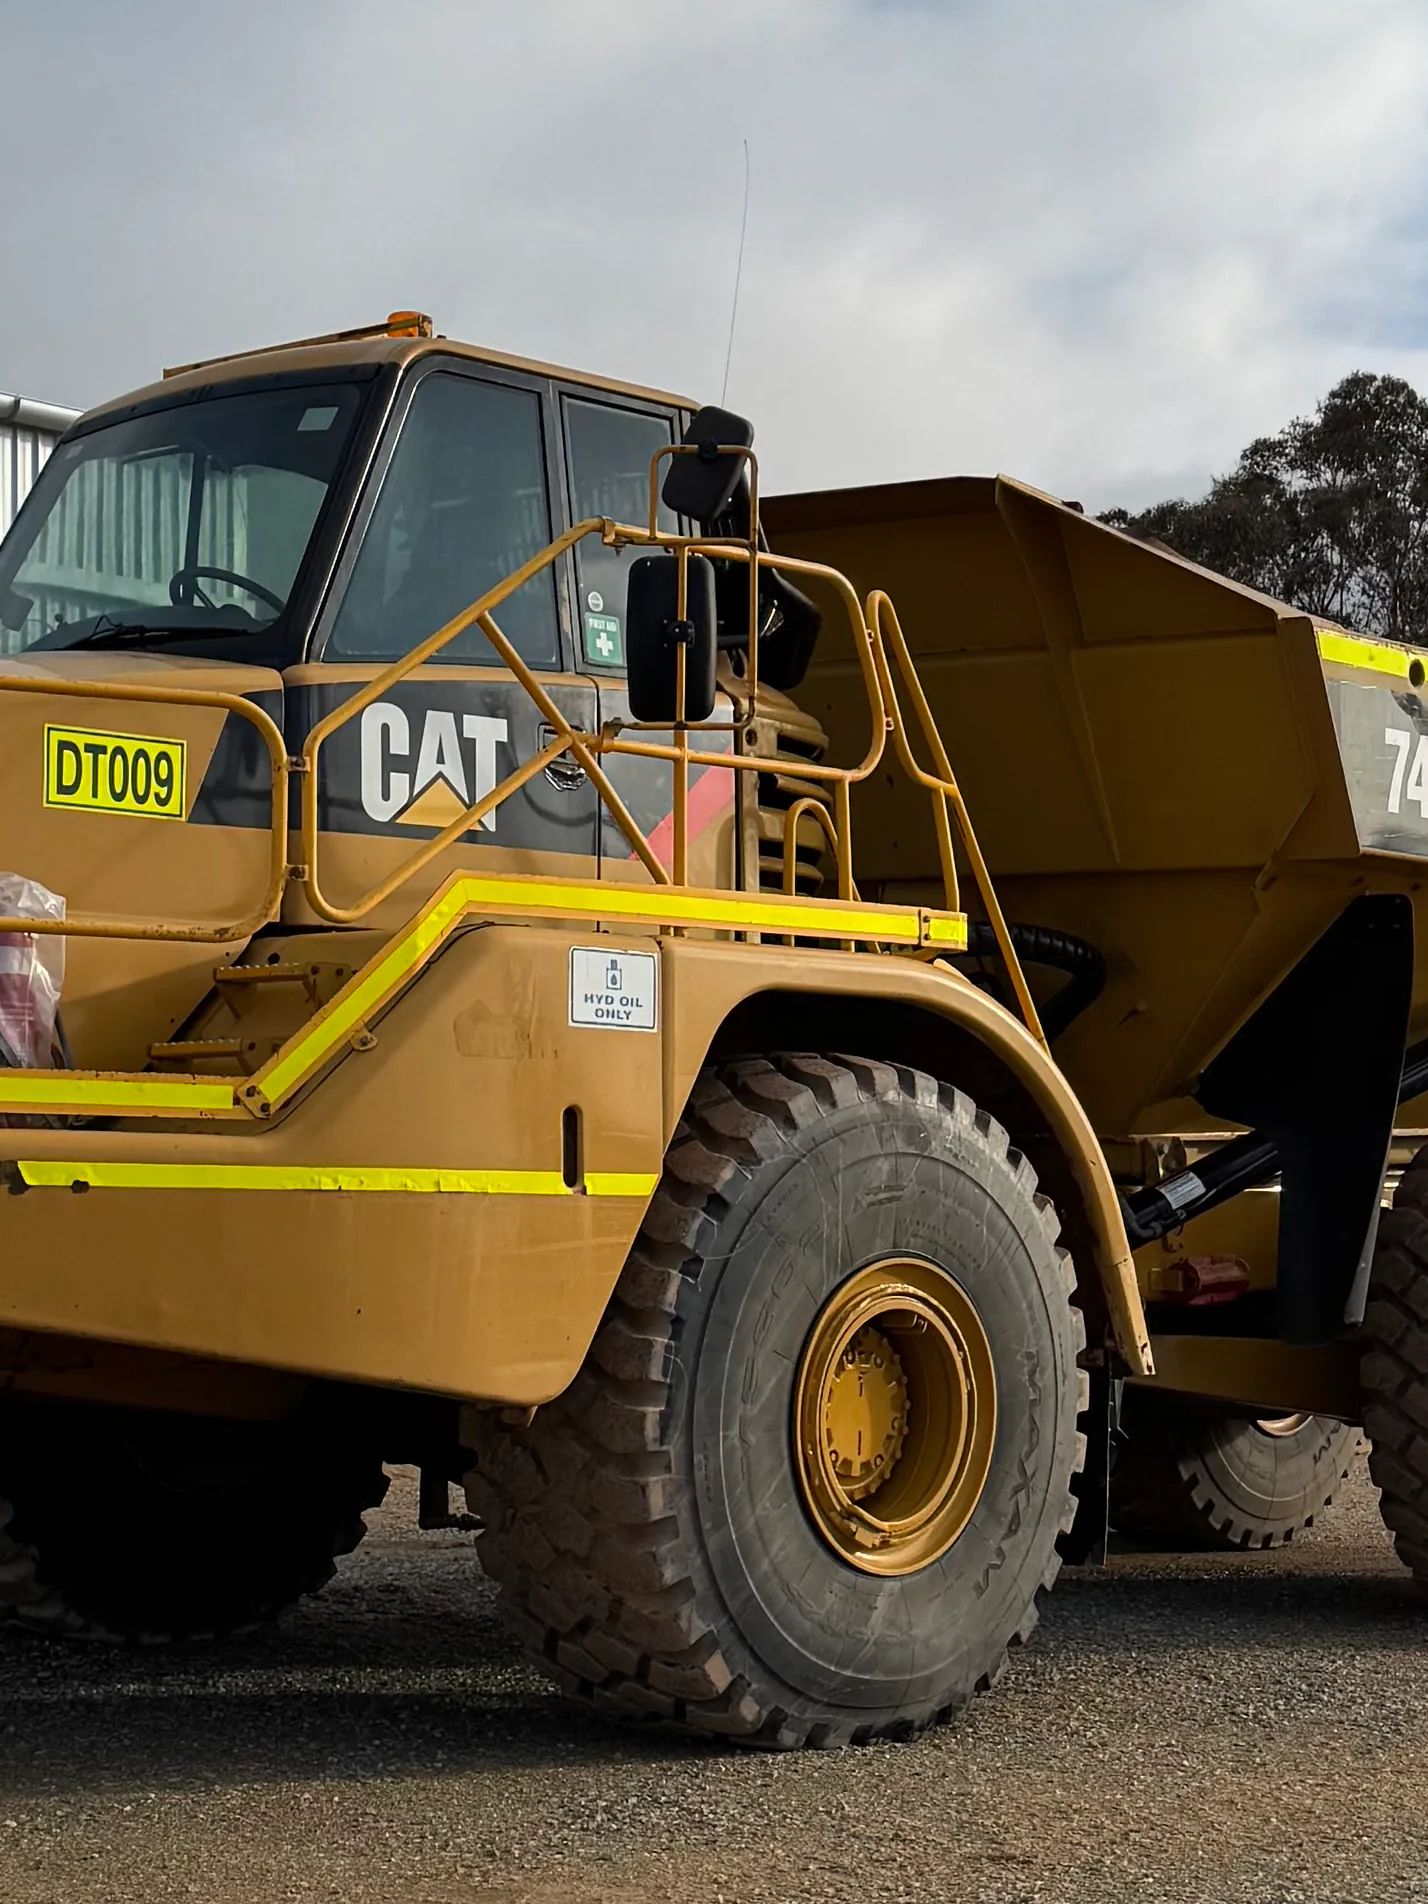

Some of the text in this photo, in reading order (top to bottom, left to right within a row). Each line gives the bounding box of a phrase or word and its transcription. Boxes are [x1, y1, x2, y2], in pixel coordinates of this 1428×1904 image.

[56, 739, 174, 807] DT009
[361, 702, 508, 832] CAT
[584, 993, 643, 1007] HYD OIL
[594, 1008, 632, 1020] ONLY
